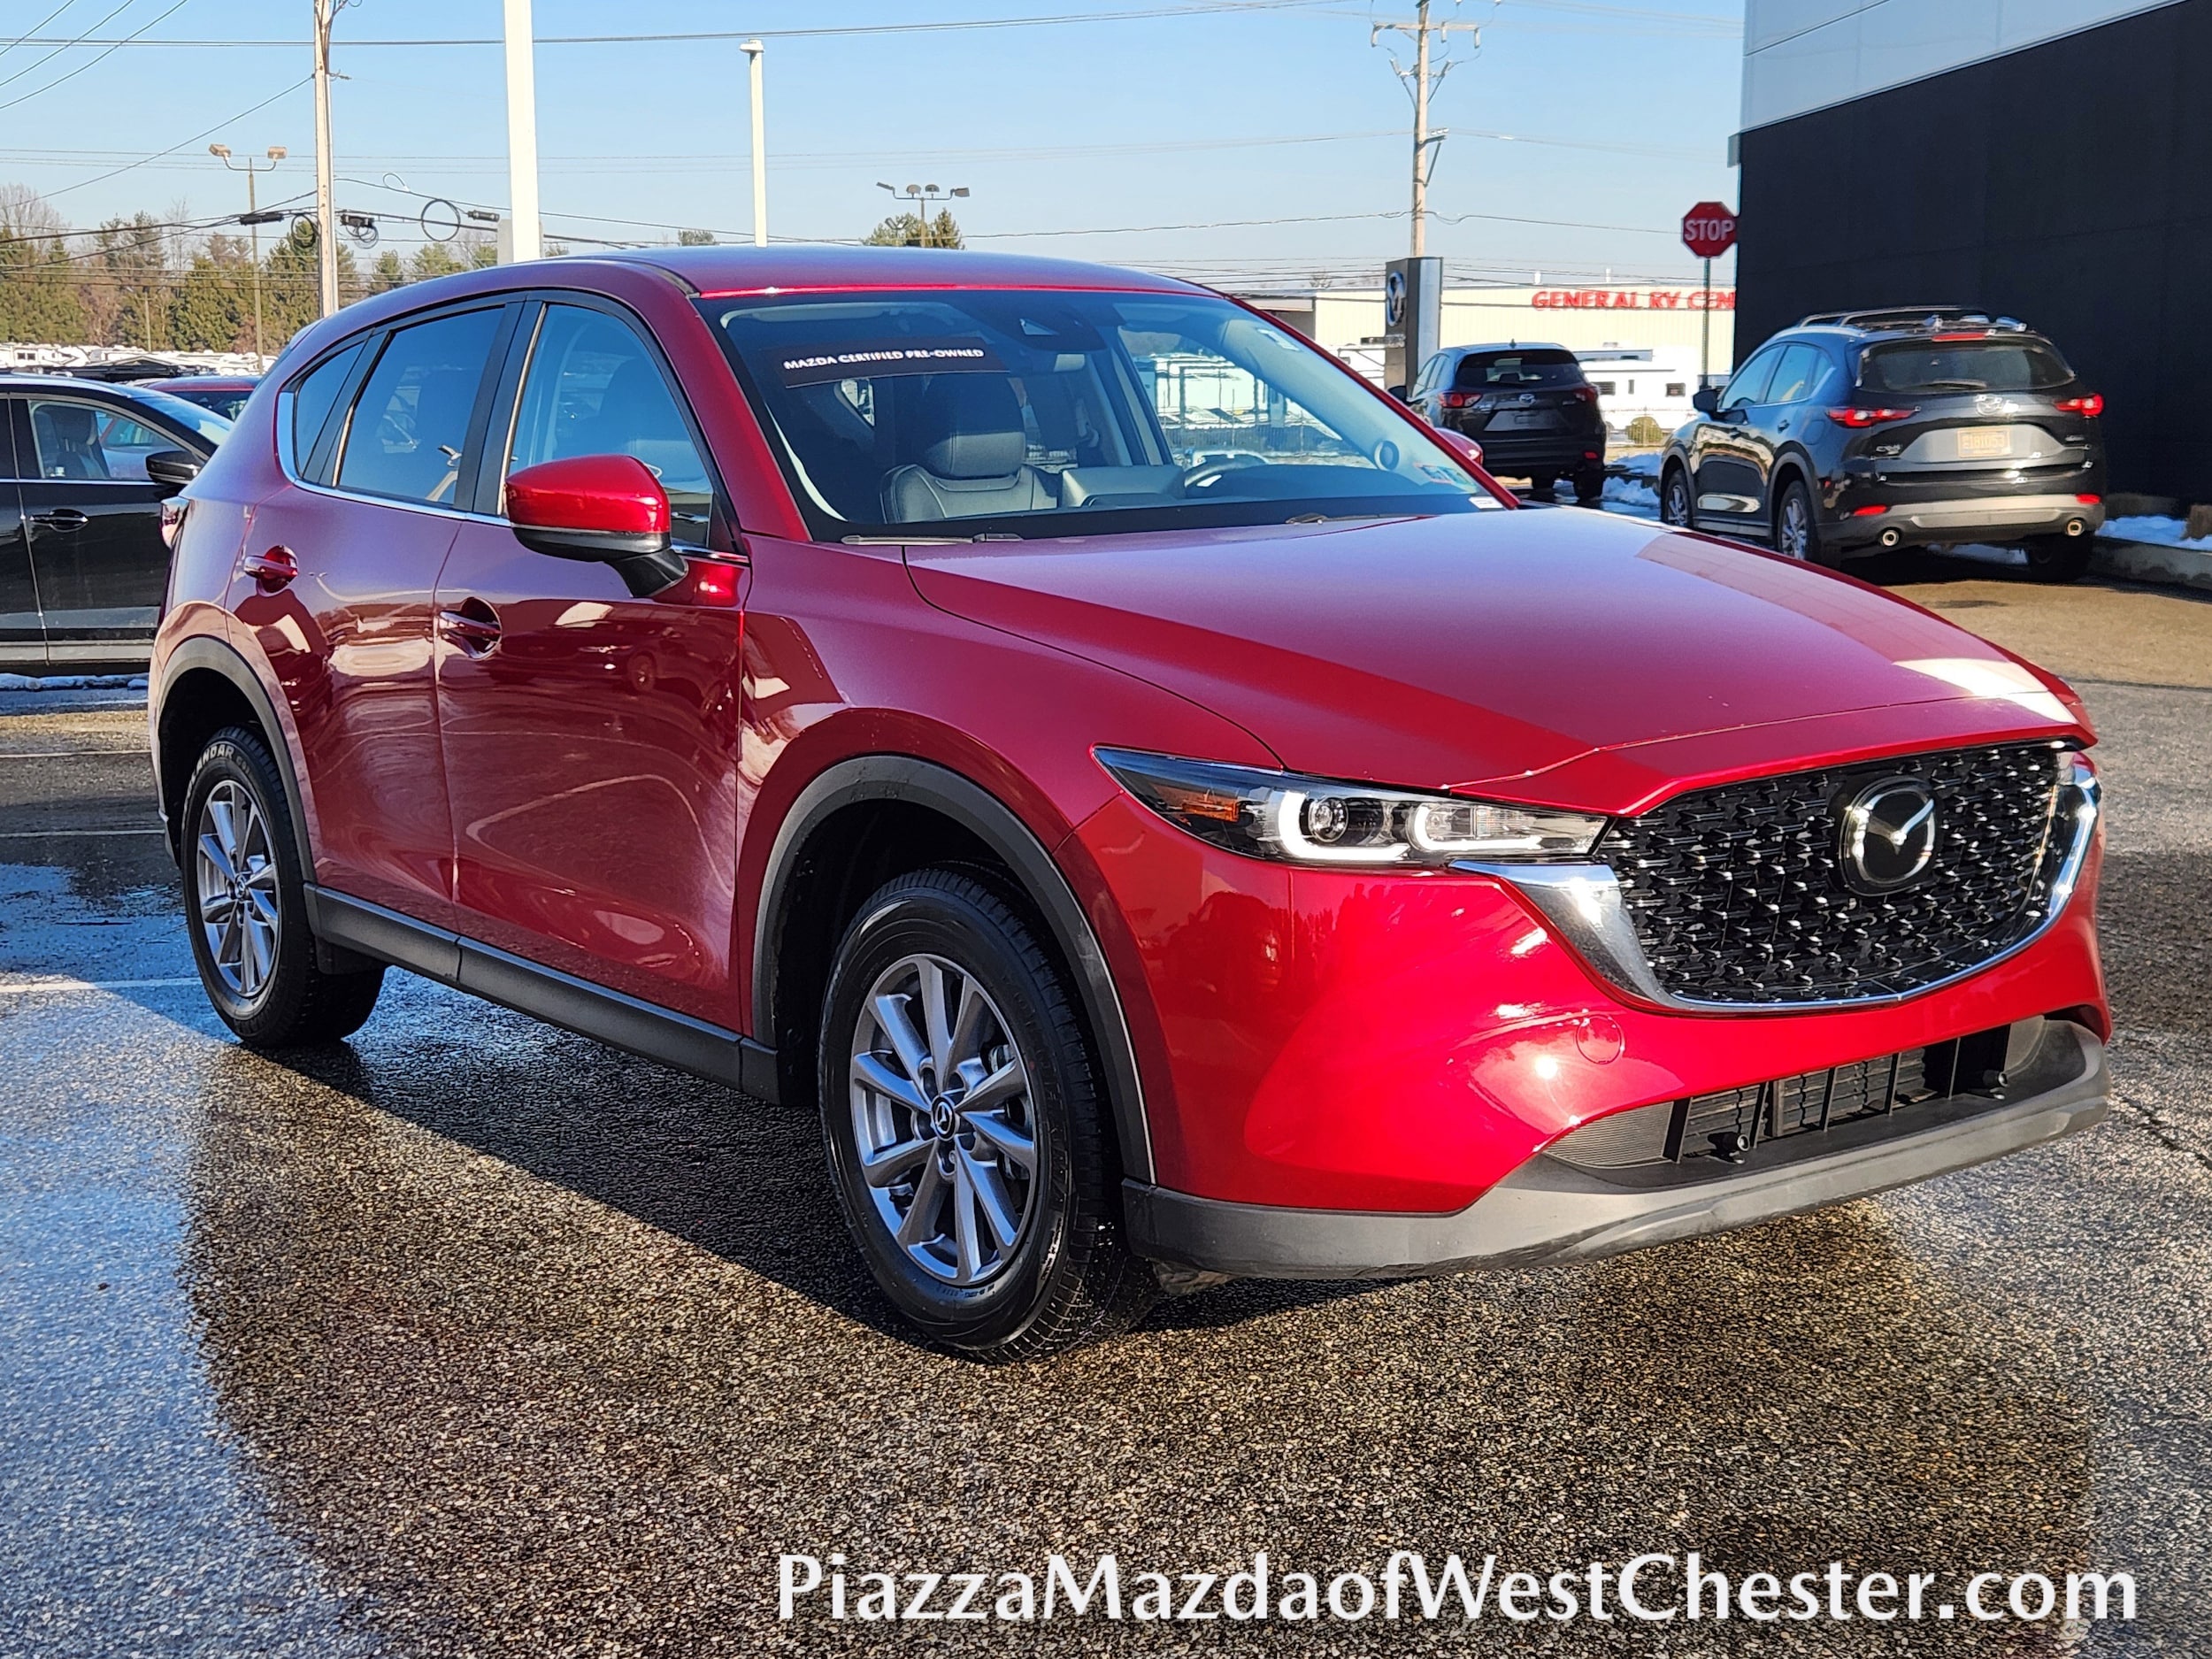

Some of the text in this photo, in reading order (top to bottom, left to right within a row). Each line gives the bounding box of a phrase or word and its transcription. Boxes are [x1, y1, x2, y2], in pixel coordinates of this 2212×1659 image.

[1684, 219, 1735, 241] STOP
[1532, 290, 1638, 310] GENERAL
[1648, 291, 1681, 309] RV
[784, 349, 984, 370] MAZDA CERTIFIED PRE-OWNED
